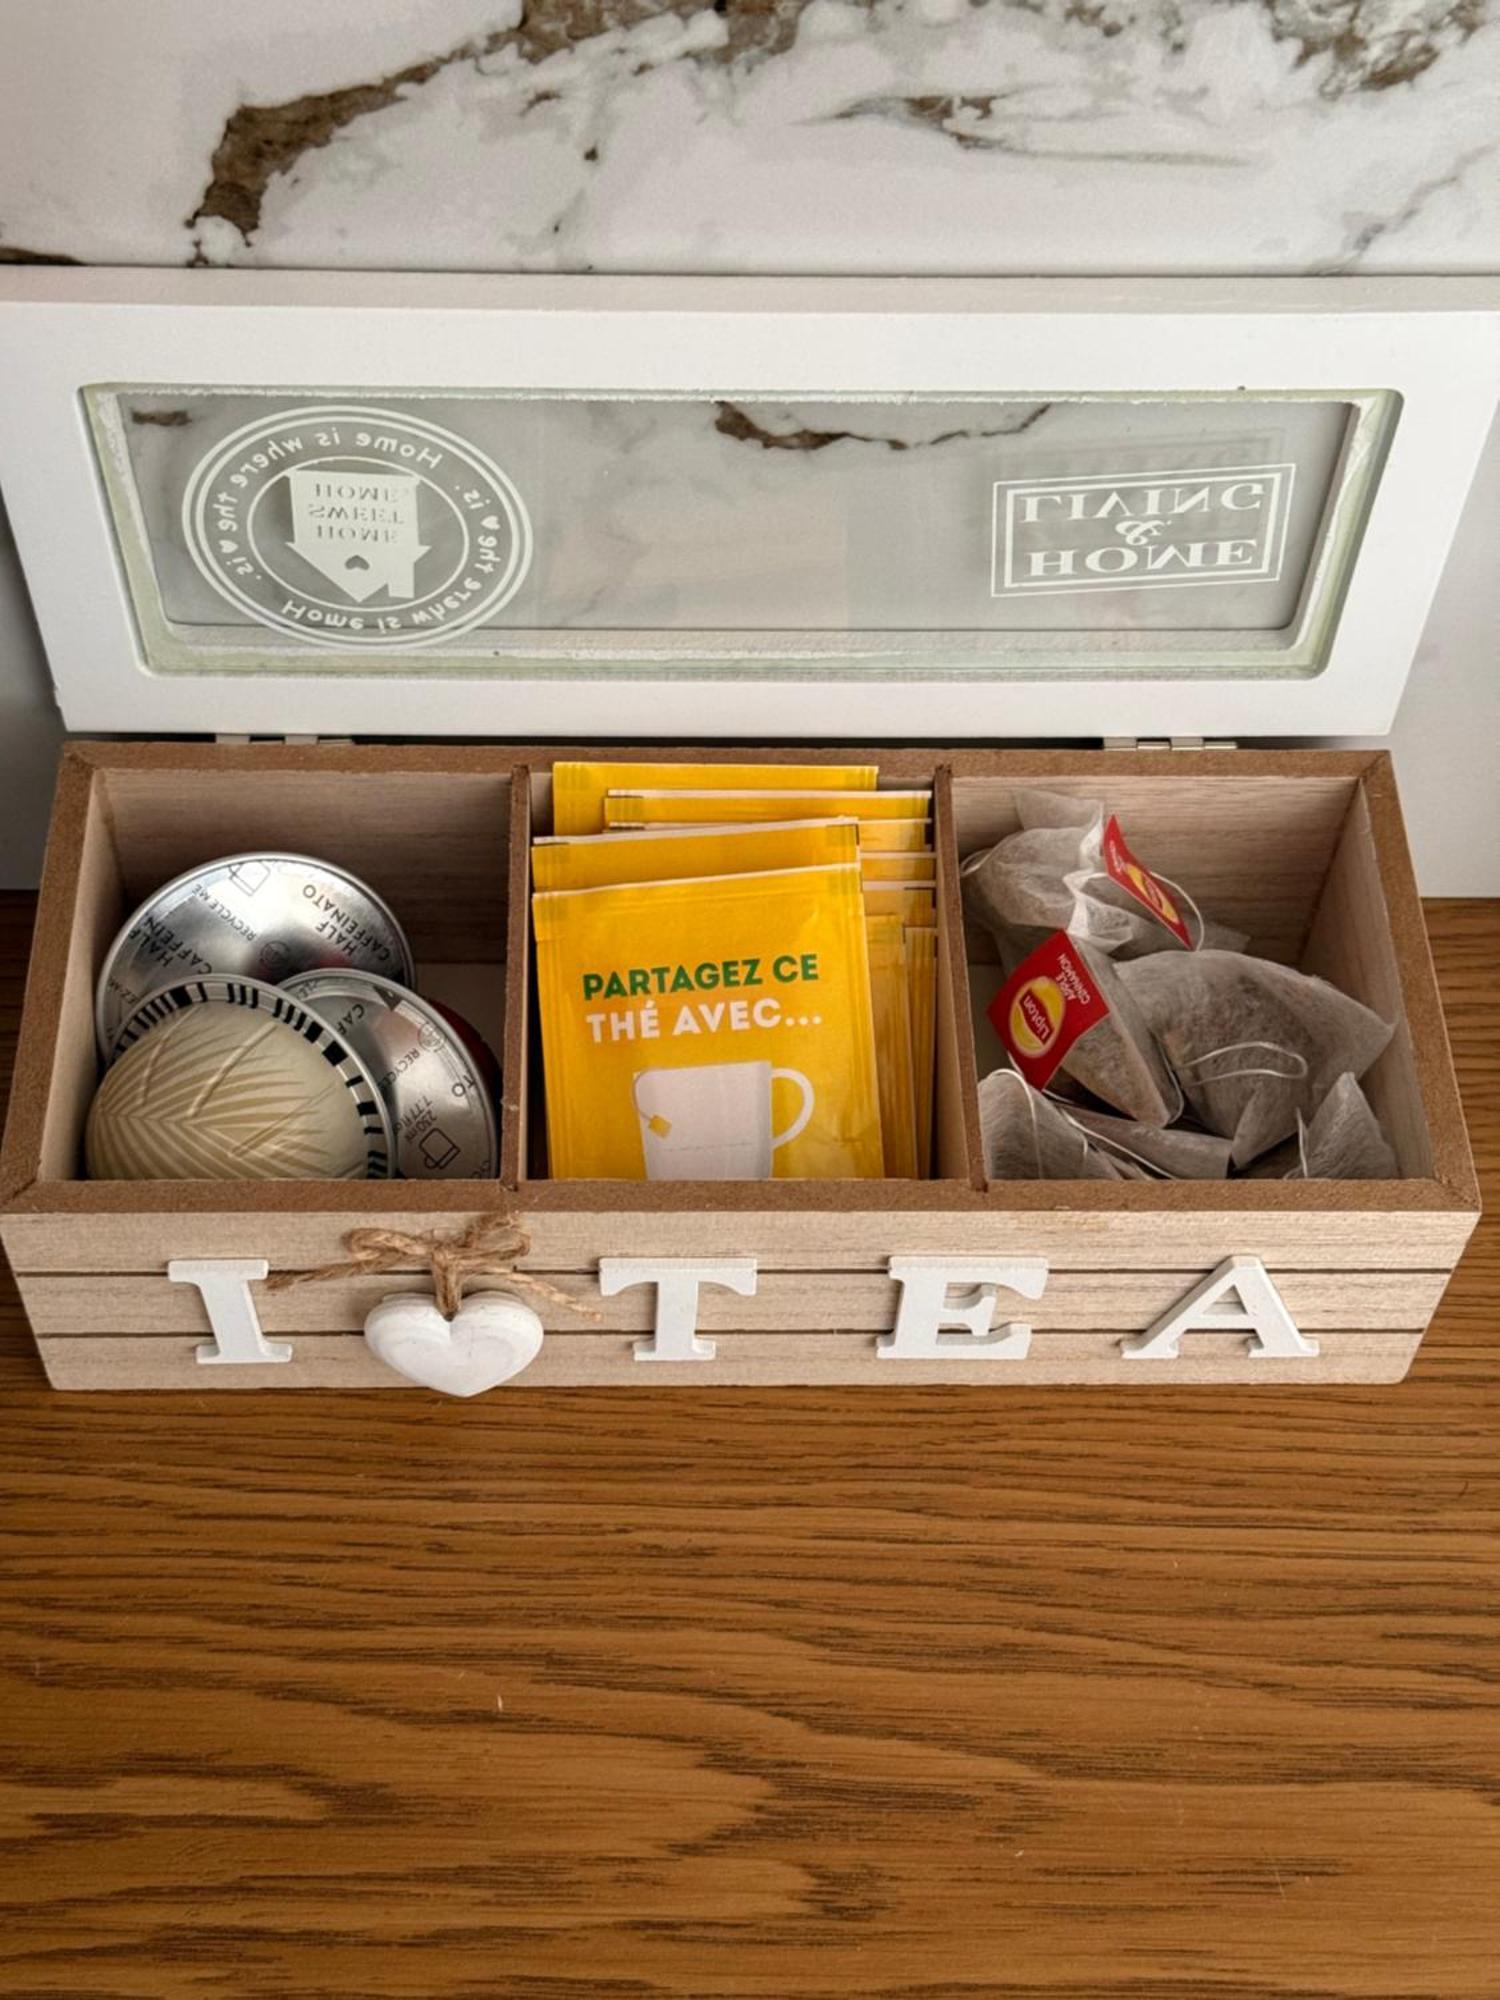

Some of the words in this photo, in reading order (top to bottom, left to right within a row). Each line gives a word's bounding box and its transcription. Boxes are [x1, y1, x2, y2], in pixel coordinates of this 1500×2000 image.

[207, 902, 258, 942] RECYCLE
[302, 883, 392, 962] CAFFEINATO
[315, 921, 361, 958] HALF
[582, 957, 764, 1001] PARTAGEZ
[772, 953, 819, 983] CE
[585, 1000, 661, 1043] THÉ
[672, 997, 823, 1037] AVEC...
[1022, 995, 1051, 1041] Lipton
[167, 1258, 293, 1365] I
[600, 1255, 1320, 1361] TEA
